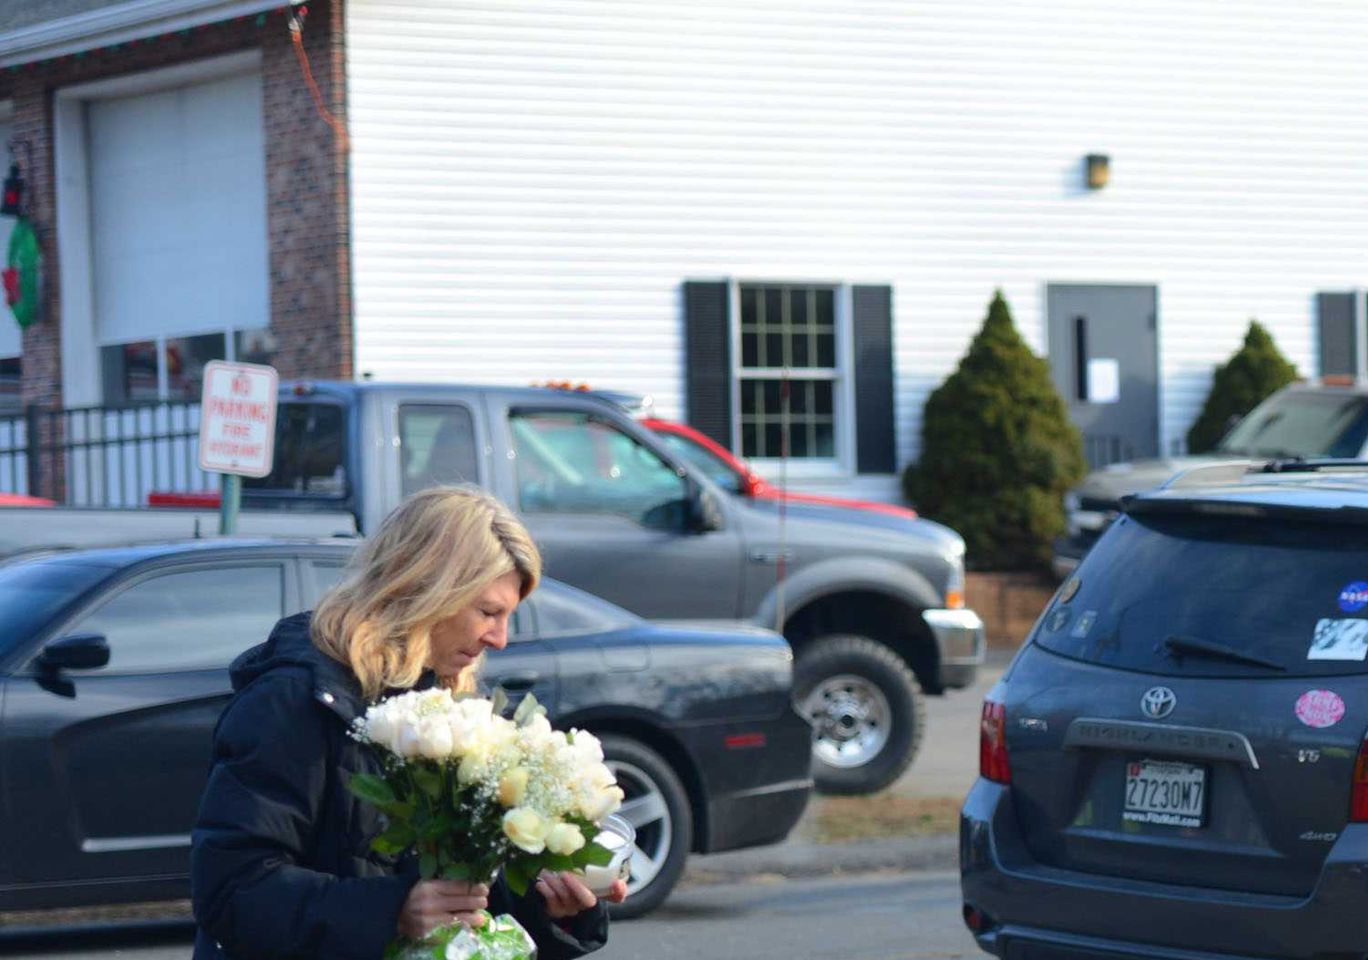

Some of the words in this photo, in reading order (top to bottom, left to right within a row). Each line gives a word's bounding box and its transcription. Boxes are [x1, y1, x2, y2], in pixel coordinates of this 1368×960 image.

[231, 376, 250, 396] NO
[211, 399, 269, 421] PARKING
[1298, 749, 1320, 763] V6
